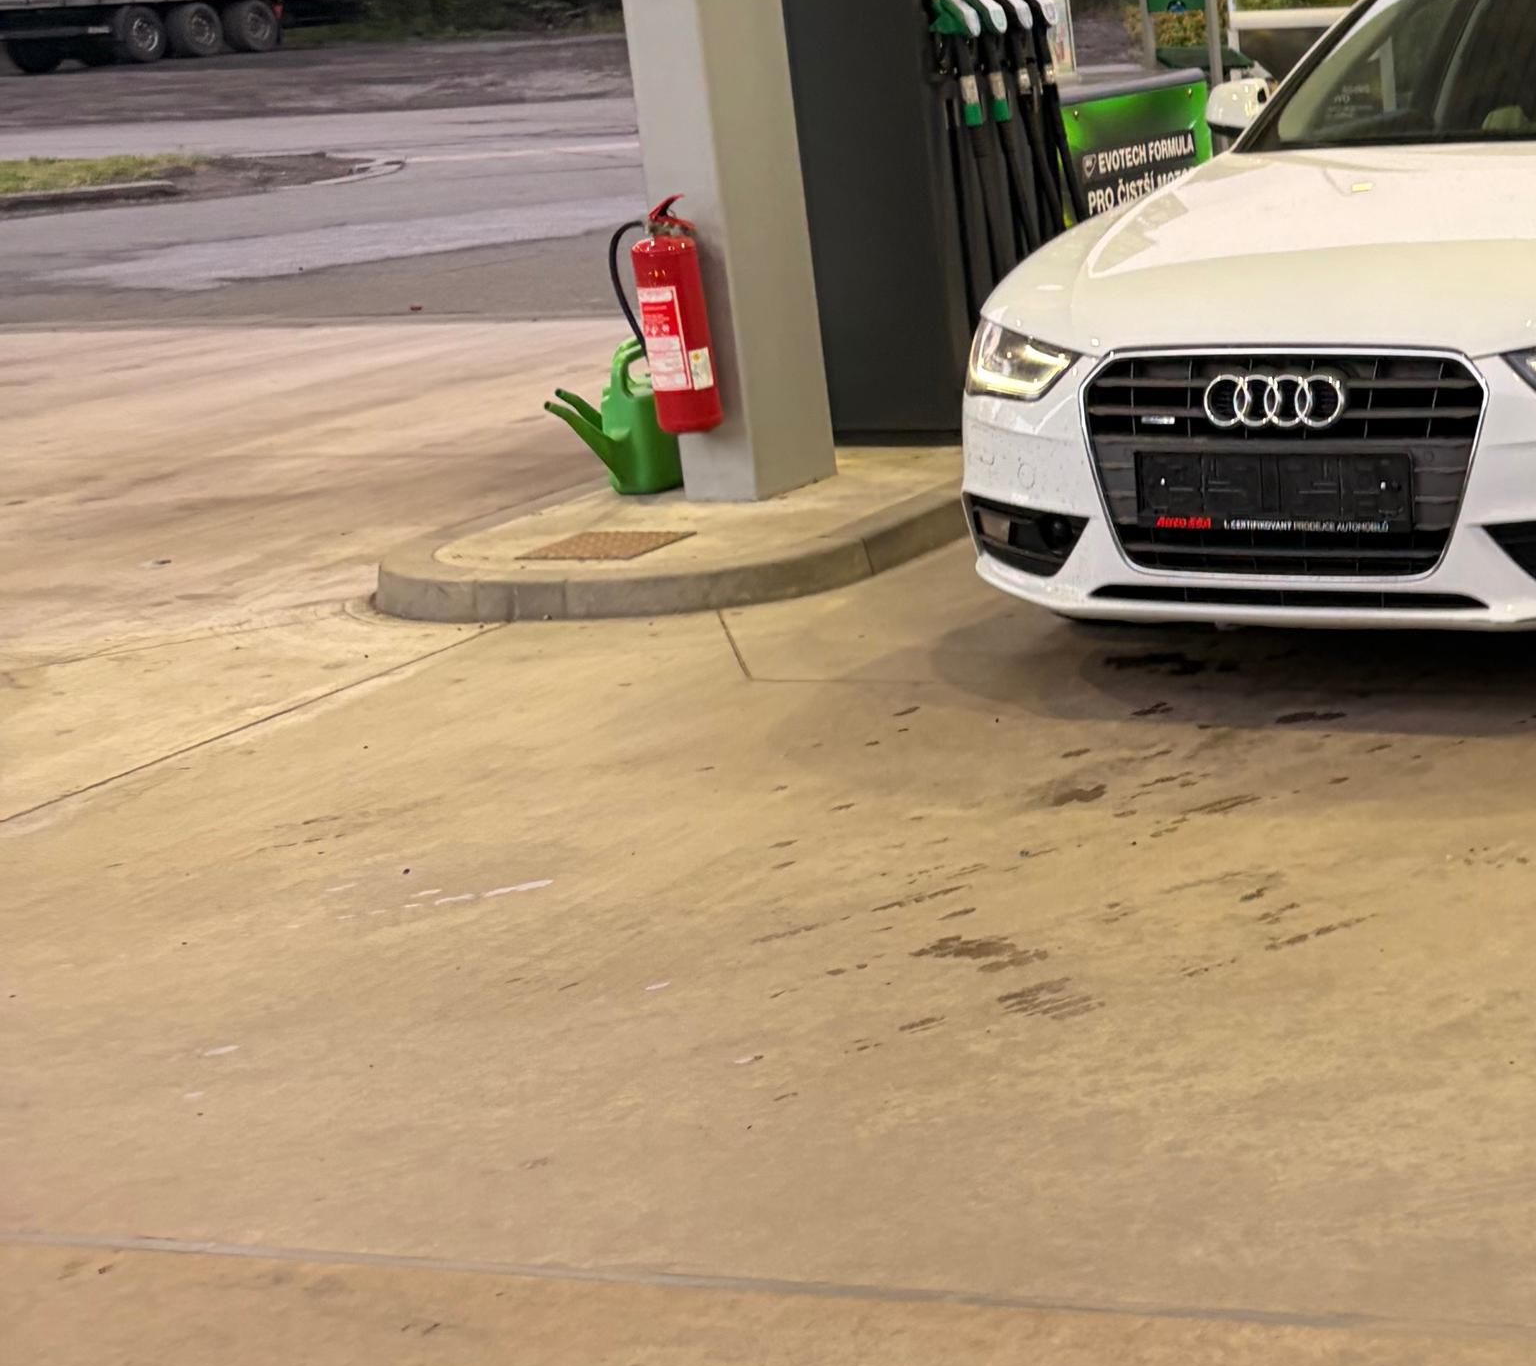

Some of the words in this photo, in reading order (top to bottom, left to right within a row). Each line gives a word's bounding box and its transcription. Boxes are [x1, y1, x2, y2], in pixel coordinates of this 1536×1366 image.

[1097, 144, 1148, 175] EVOTECH
[1148, 133, 1195, 163] FORMULA
[1087, 186, 1115, 216] PRO
